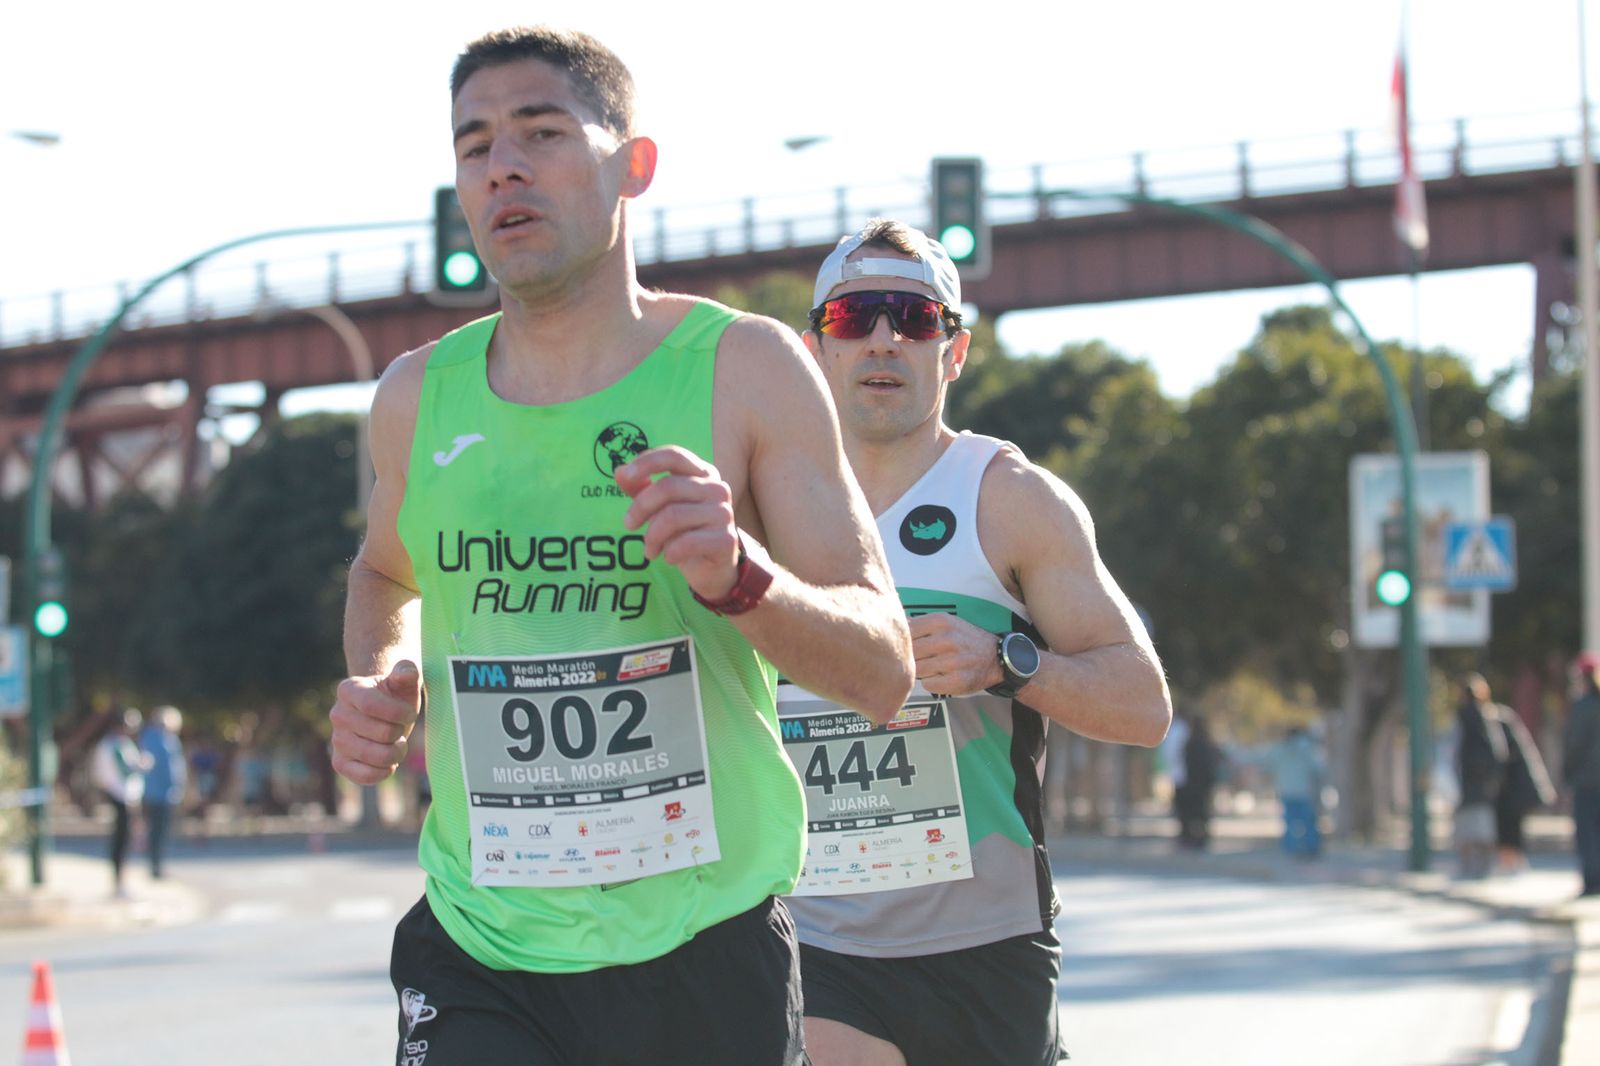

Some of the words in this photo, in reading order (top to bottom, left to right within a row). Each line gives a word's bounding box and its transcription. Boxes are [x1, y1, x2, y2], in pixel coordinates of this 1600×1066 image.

[581, 485, 602, 498] Club
[438, 530, 650, 572] Universo
[472, 577, 651, 621] Running
[512, 664, 543, 676] Medio
[547, 661, 596, 673] Maratón
[513, 674, 560, 688] Almería
[561, 671, 597, 684] 2022
[501, 689, 653, 762] 902
[808, 718, 833, 728] Medio
[809, 726, 845, 738] Almería
[846, 722, 872, 734] 2022
[493, 766, 565, 783] MIGUEL
[571, 752, 670, 781] MORALES
[805, 736, 916, 794] 444
[560, 781, 594, 791] MORALES
[596, 778, 627, 789] FRANCO
[829, 794, 890, 812] JUANRA
[483, 825, 509, 837] NEXA
[529, 822, 552, 836] CDX
